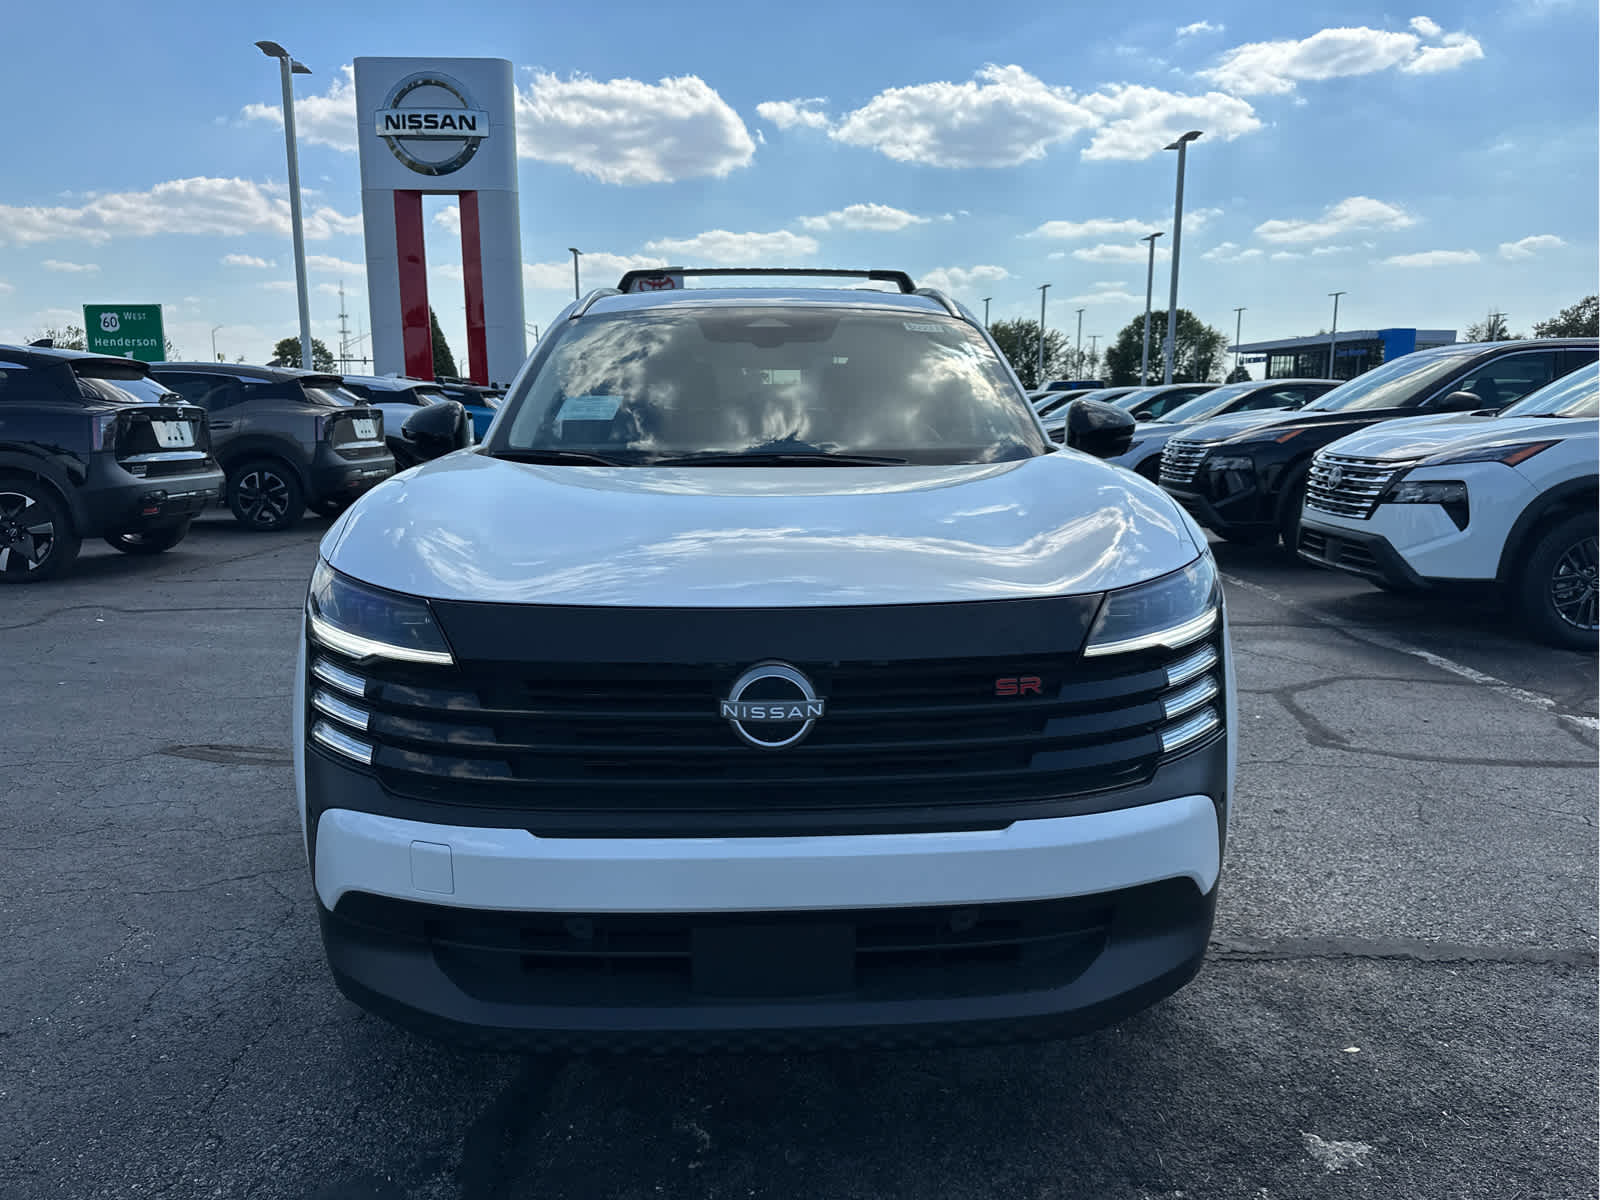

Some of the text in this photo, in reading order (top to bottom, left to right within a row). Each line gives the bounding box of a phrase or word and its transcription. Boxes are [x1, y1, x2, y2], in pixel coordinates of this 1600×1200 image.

[385, 114, 476, 130] NISSAN
[102, 317, 118, 328] 60
[94, 337, 157, 346] Henderson
[995, 677, 1042, 695] SR
[722, 703, 823, 719] NISSAN
